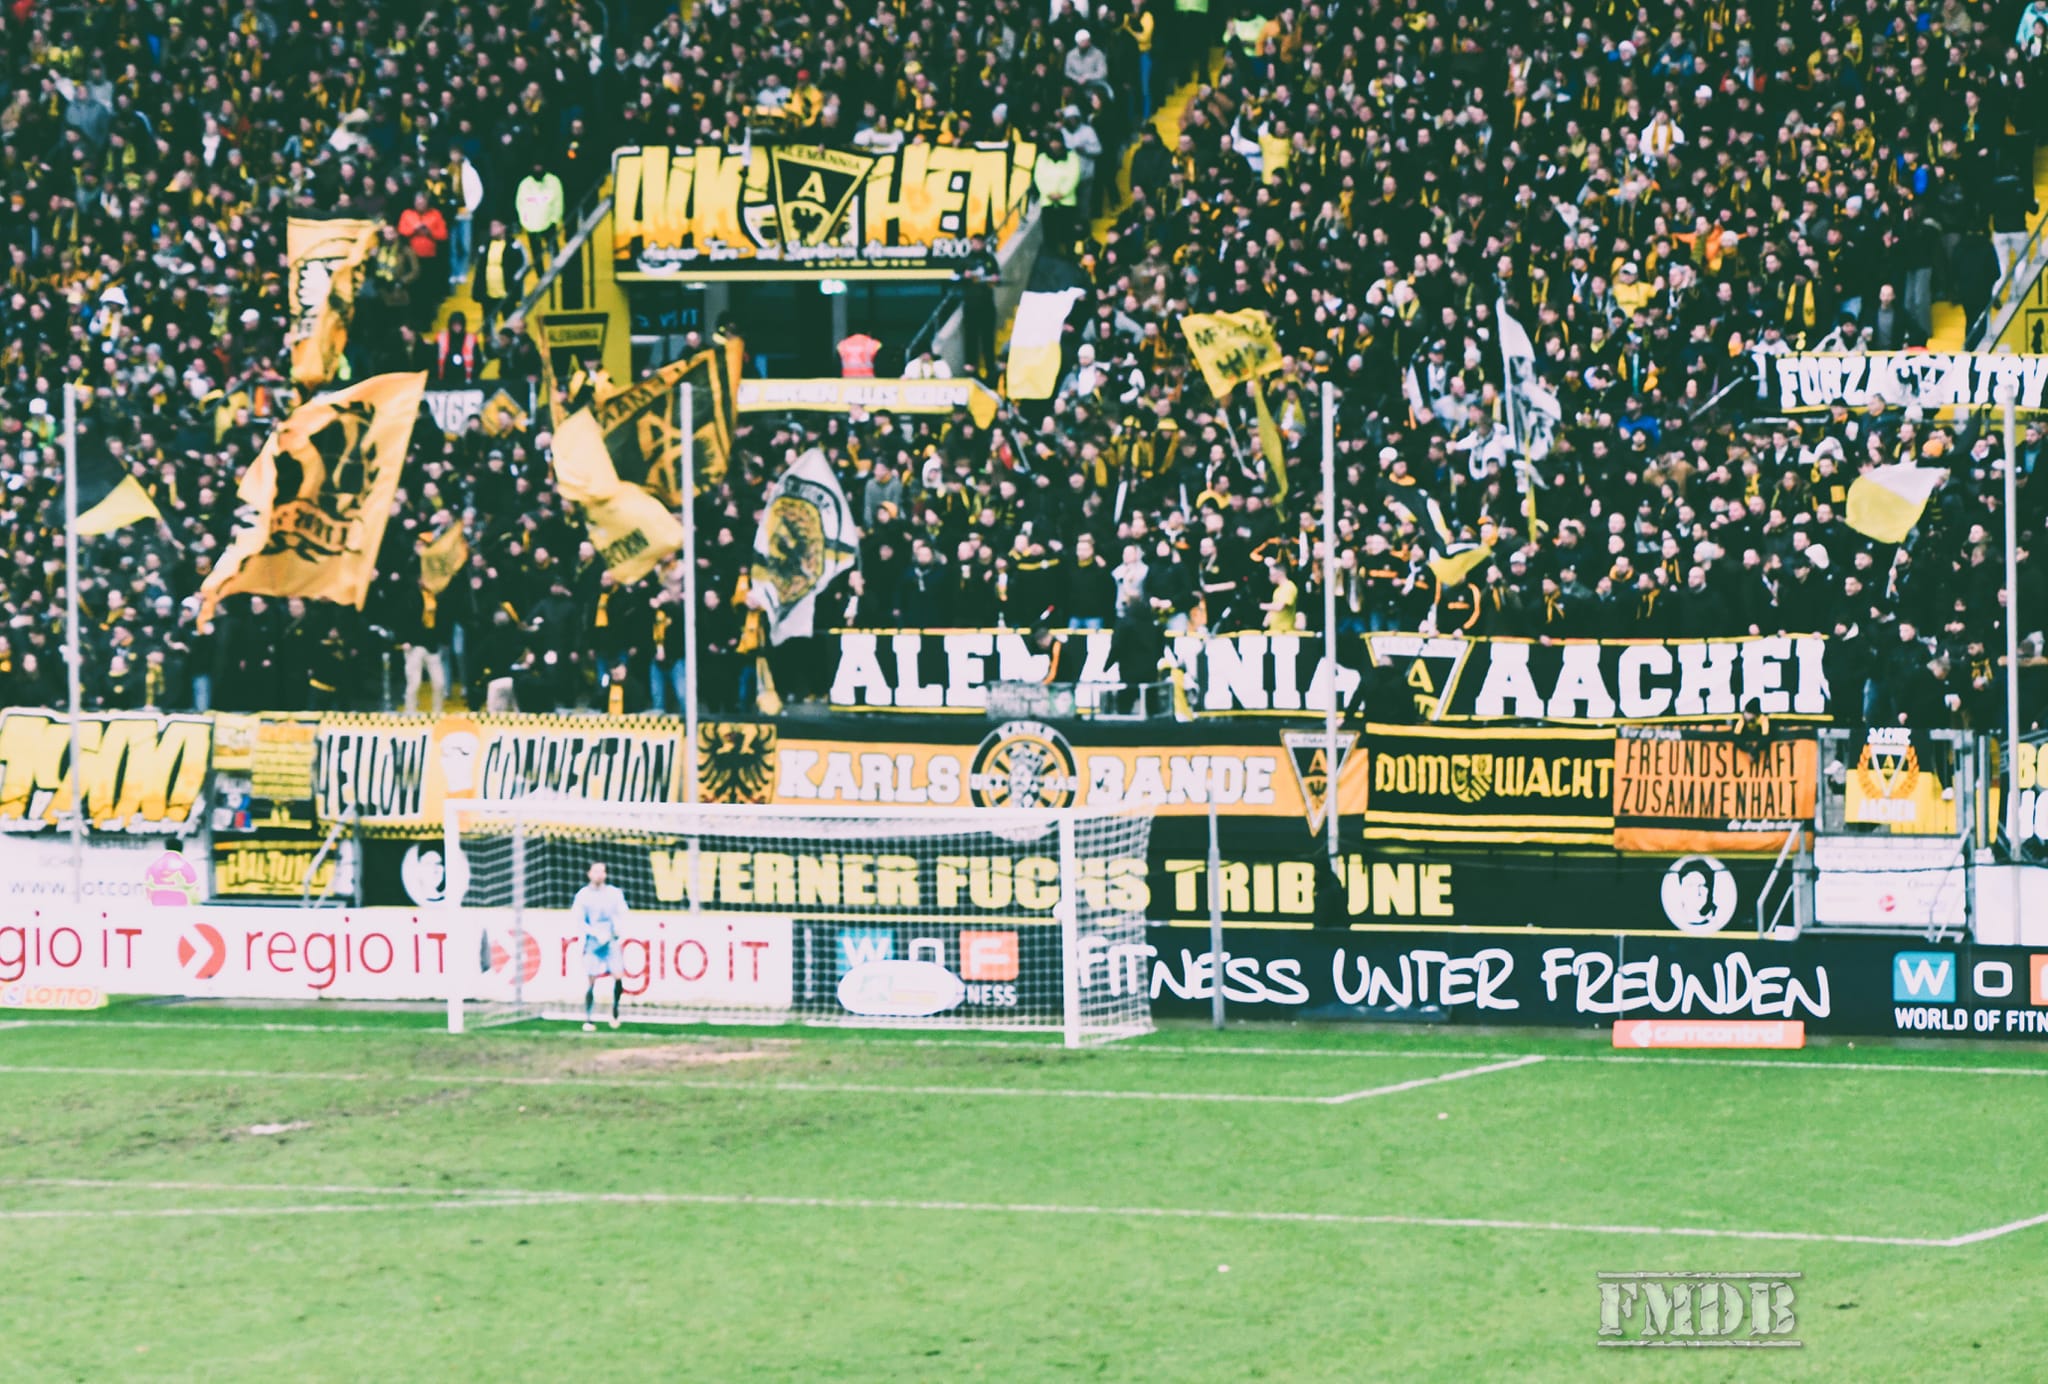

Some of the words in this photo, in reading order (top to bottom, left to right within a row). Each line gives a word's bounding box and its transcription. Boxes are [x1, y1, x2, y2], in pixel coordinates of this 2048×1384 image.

[797, 170, 826, 203] A
[932, 238, 972, 258] 1900
[830, 634, 1362, 710] ALEMANIA
[316, 734, 428, 817] YELLOW
[483, 735, 676, 802] CONNECTION
[777, 750, 961, 803] KARLS
[1086, 756, 1276, 804] BANDE
[1494, 755, 1613, 799] WACHT
[1626, 740, 1796, 779] FREUNDSCHAFT
[1620, 778, 1797, 817] ZUSAMMENHALT
[650, 849, 919, 907] WERNER
[936, 854, 1151, 912] FUCHS
[1165, 853, 1454, 916] TRIBÜNE
[246, 917, 394, 989] regio
[561, 922, 708, 996] rgio
[1076, 936, 1309, 1005] FITNESS
[1333, 948, 1518, 1010] UNTER
[1542, 947, 1831, 1018] FREUNDEN
[25, 986, 94, 1005] LOTTO
[1894, 1007, 1968, 1031] WORLD
[1974, 1009, 2001, 1032] OF
